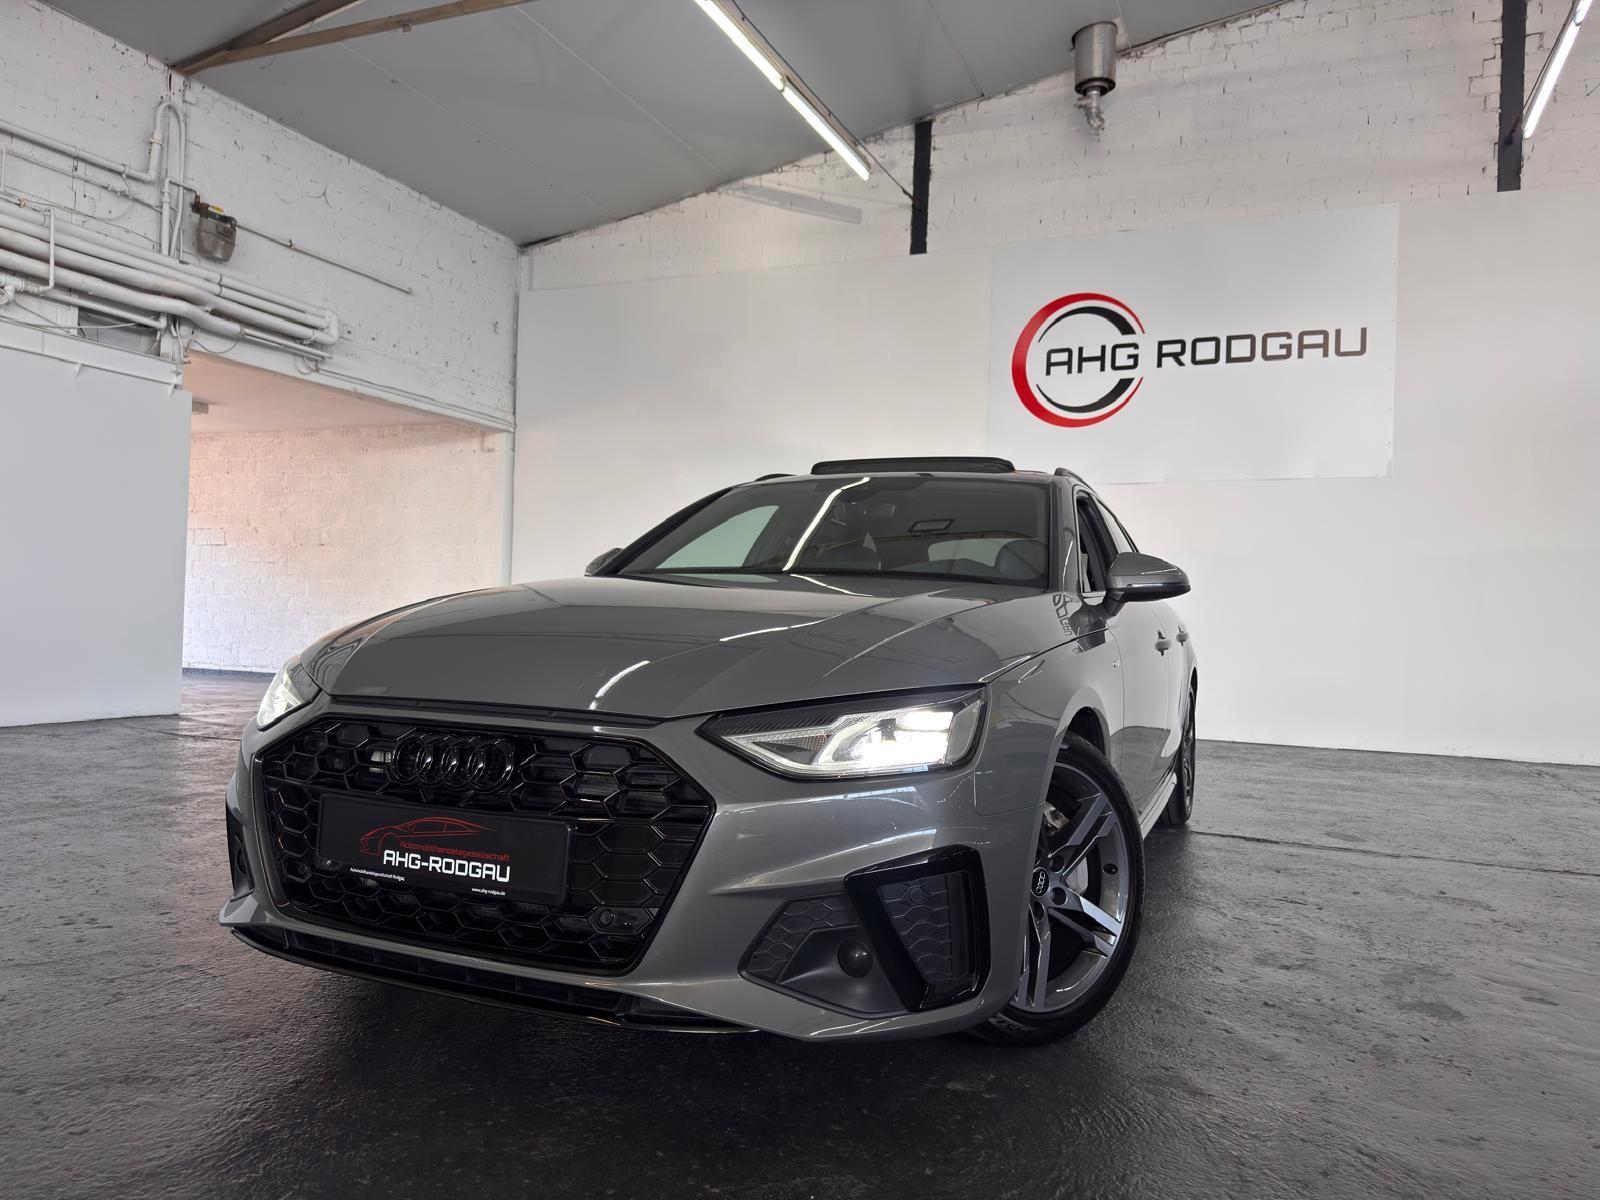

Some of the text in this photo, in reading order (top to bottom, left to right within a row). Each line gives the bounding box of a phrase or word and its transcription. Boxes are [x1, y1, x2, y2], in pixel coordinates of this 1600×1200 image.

[1045, 327, 1368, 377] AHG RODGAU
[382, 849, 511, 883] AHG-RODGAU
